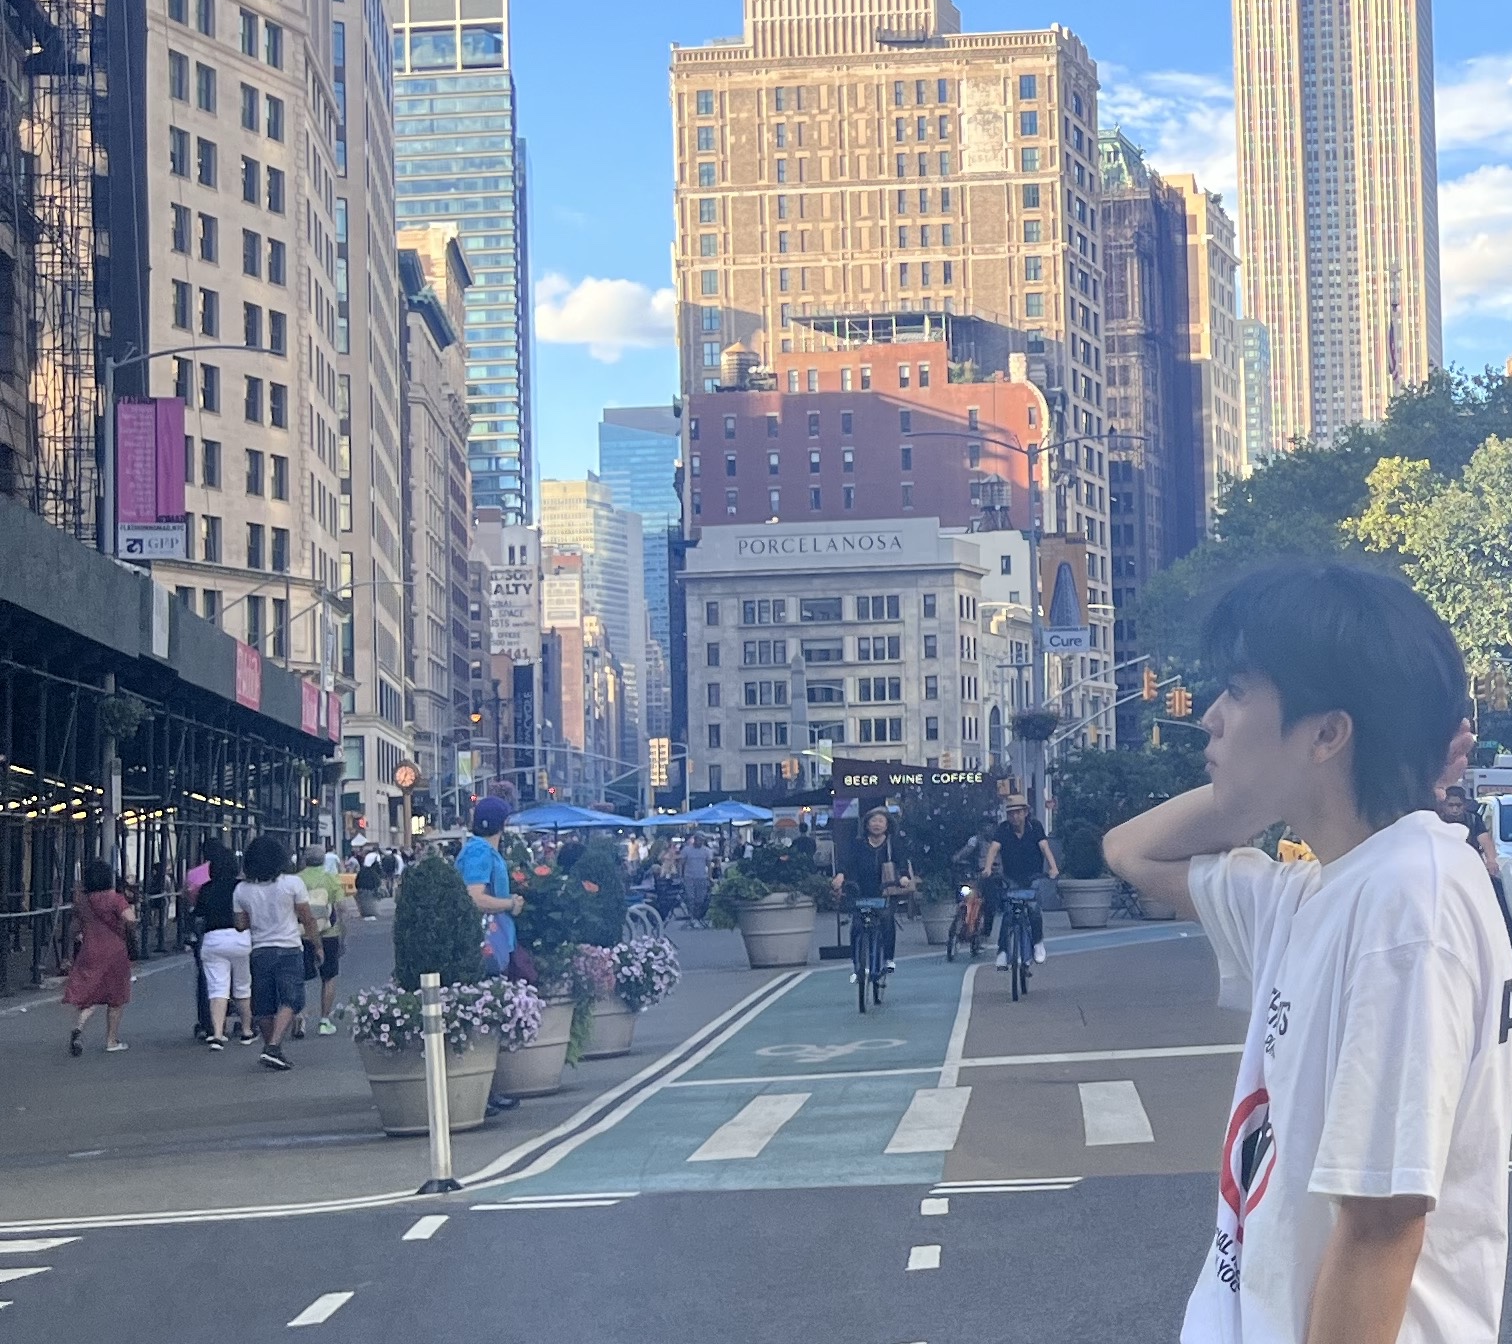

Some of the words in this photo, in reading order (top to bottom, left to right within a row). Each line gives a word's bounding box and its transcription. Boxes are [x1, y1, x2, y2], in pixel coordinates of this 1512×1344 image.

[738, 535, 902, 555] PORCELANOSA
[1049, 634, 1083, 648] Cure
[843, 774, 879, 786] BEER
[889, 773, 924, 785] WINE
[931, 772, 983, 784] COFFEE
